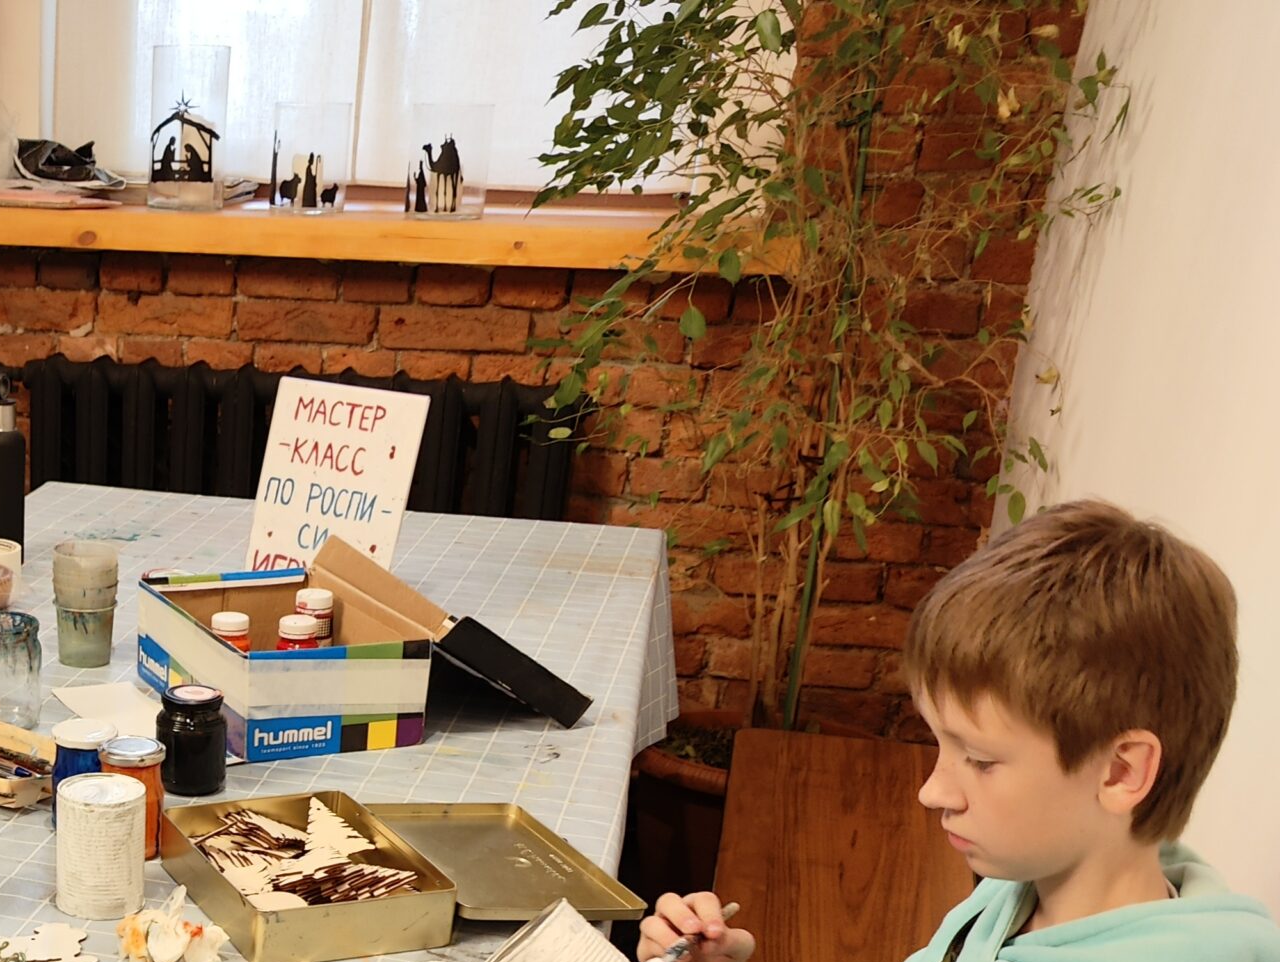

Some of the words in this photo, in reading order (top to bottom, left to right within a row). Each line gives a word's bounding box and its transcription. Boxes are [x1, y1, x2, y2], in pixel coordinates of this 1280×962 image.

[293, 396, 387, 433] МАСТЕР
[278, 437, 367, 477] -КЛАСС
[263, 477, 296, 506] ПО
[297, 523, 329, 550] СИ
[253, 720, 333, 748] hummel
